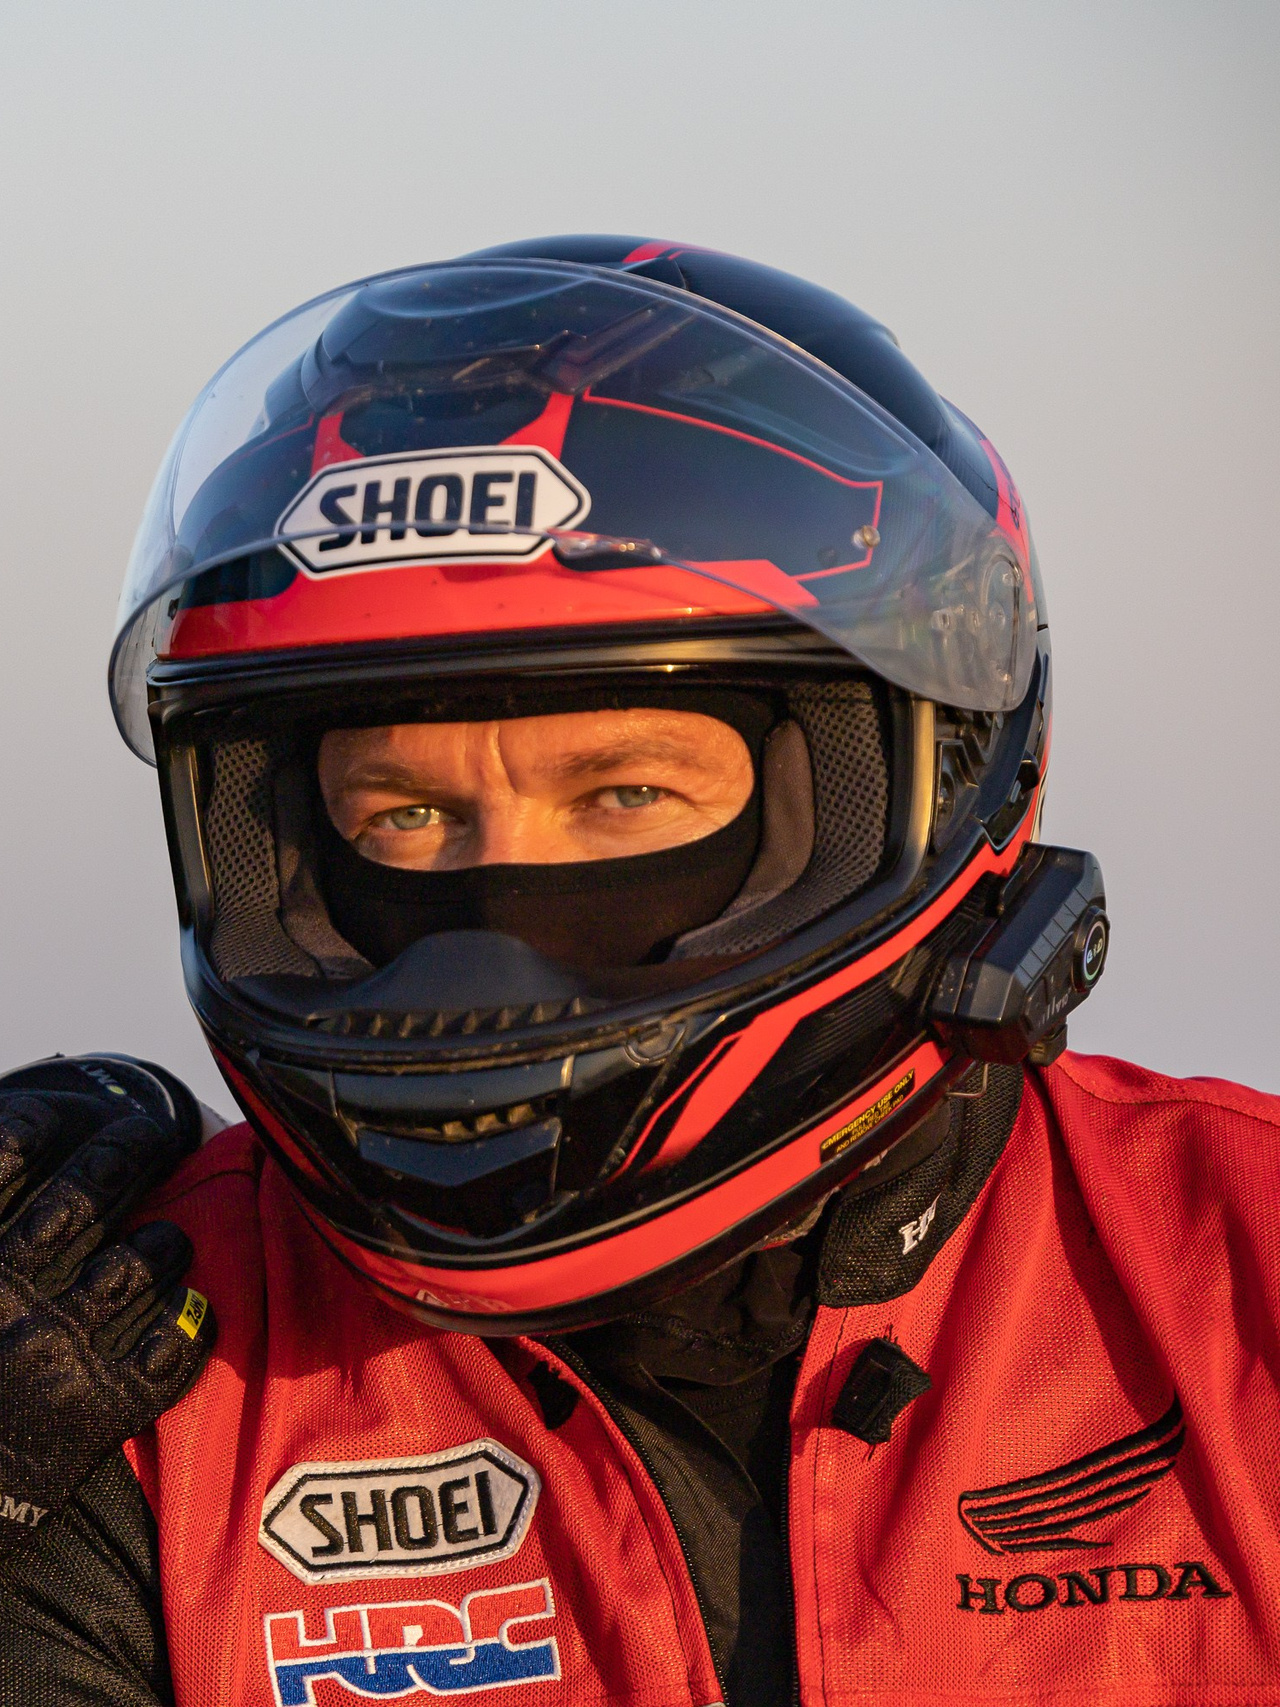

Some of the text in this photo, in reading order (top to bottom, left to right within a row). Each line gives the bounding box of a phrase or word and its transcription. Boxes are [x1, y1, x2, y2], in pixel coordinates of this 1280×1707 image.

[318, 471, 538, 552] SHOEI
[821, 1069, 914, 1150] EMERGENCY USE ONLY
[299, 1471, 498, 1557] SHOEI
[955, 1562, 1232, 1615] HONDA
[264, 1577, 561, 1707] HRC
